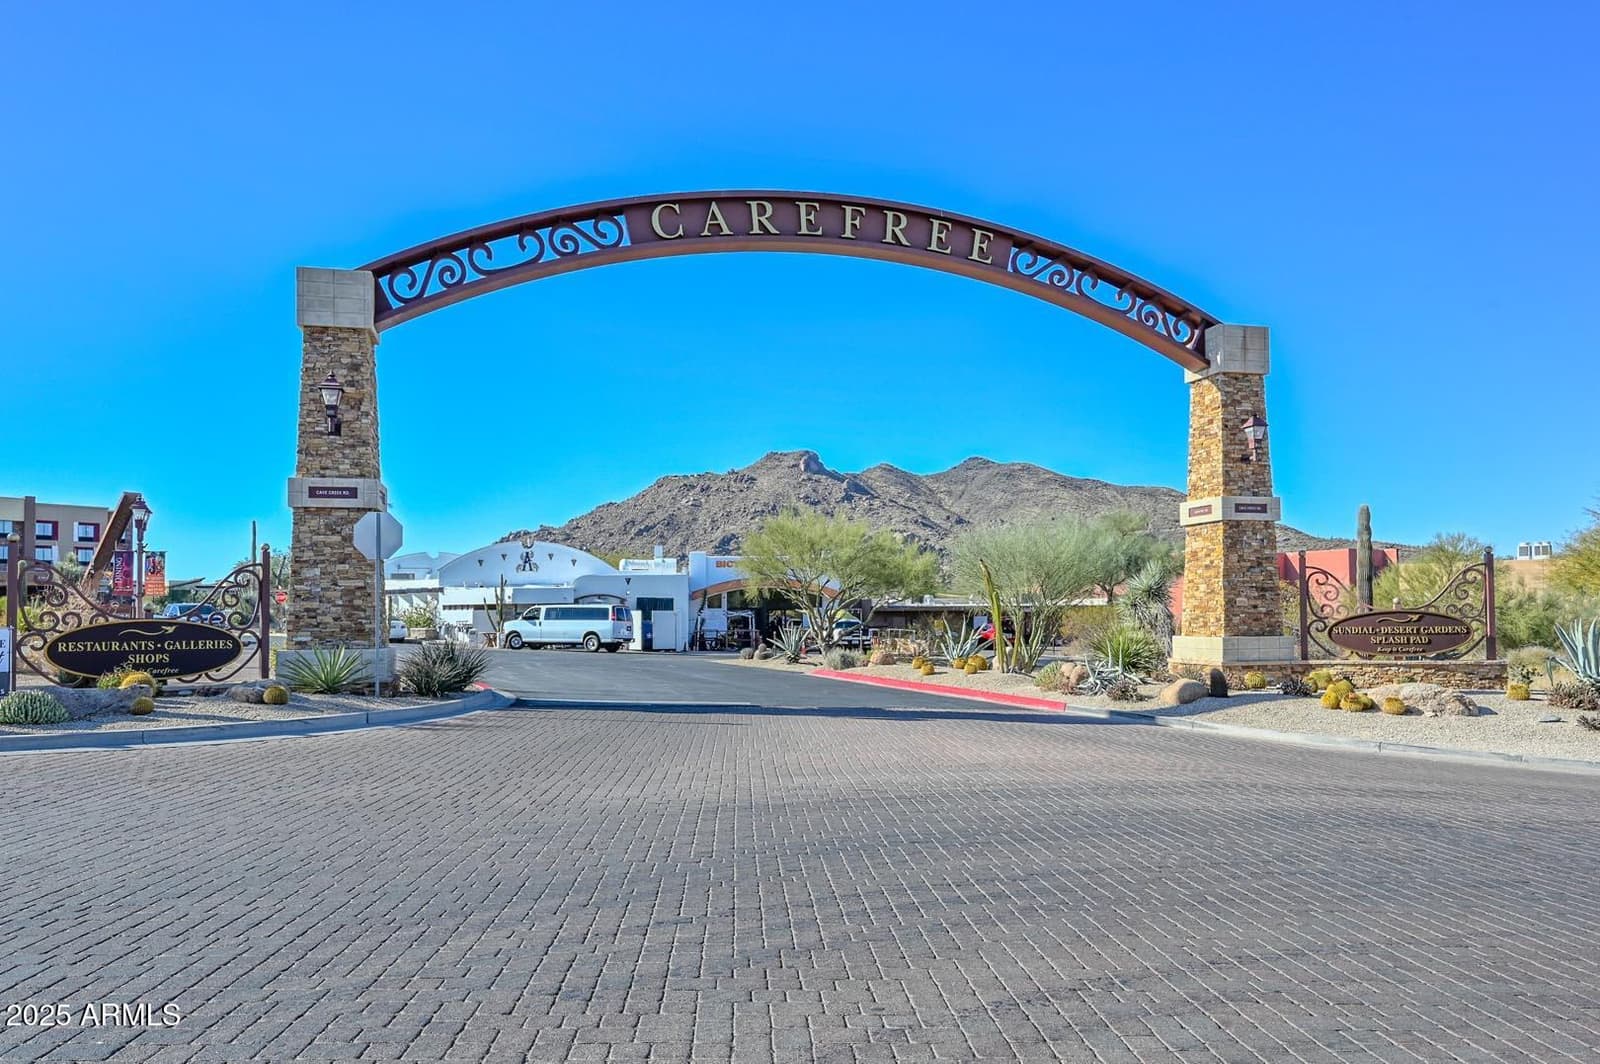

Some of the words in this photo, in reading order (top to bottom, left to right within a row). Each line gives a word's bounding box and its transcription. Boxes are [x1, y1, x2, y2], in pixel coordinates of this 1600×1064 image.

[650, 200, 995, 265] CAREFREE
[114, 556, 123, 585] DINING
[1332, 626, 1376, 634] SUNDIAL
[1381, 626, 1418, 634] DESERT
[1420, 626, 1467, 634] GARDENS
[1370, 636, 1408, 644] SPLASH
[1410, 636, 1429, 644] PAD
[57, 641, 155, 652] RESTAURANTS
[164, 640, 233, 650] GALLERIES
[128, 653, 170, 663] SHOPS
[147, 667, 180, 676] Carefree
